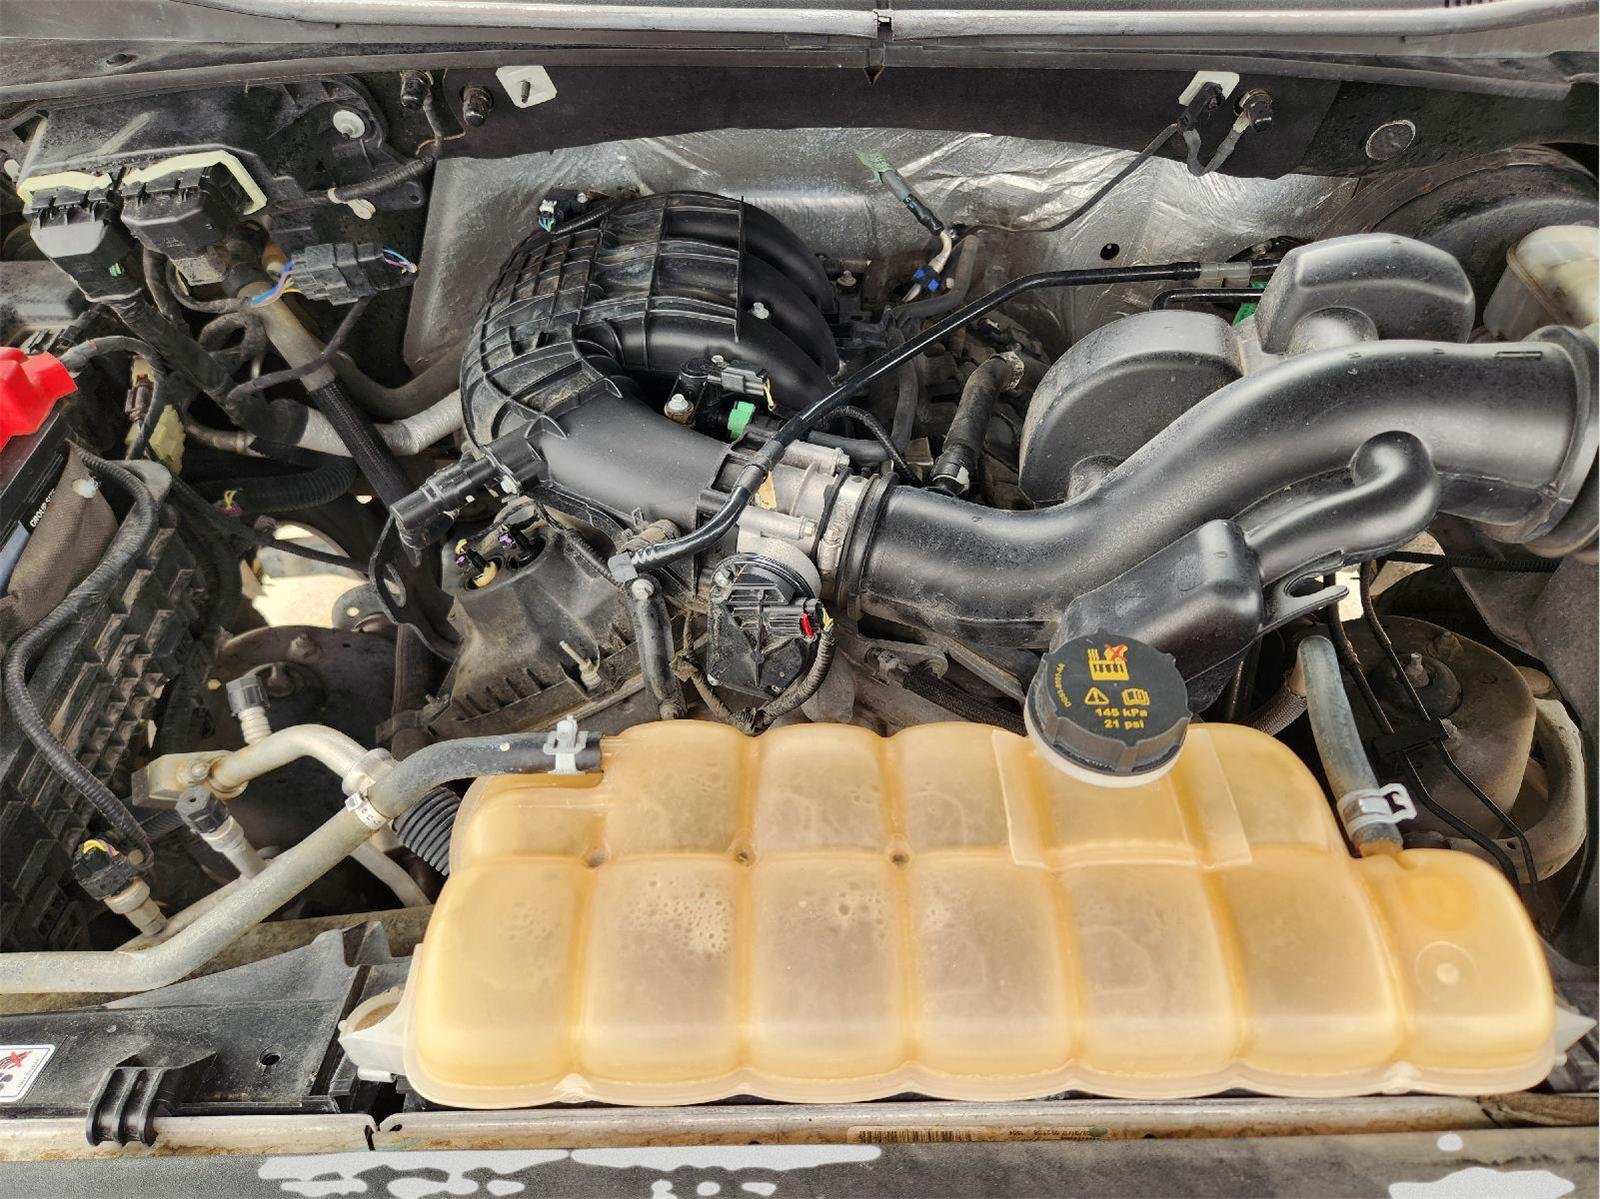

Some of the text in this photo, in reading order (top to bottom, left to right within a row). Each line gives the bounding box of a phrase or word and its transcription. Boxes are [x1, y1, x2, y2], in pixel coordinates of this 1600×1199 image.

[29, 502, 47, 527] GROUP
[1095, 707, 1148, 717] 145 kPa
[1104, 719, 1145, 730] 21 psi
